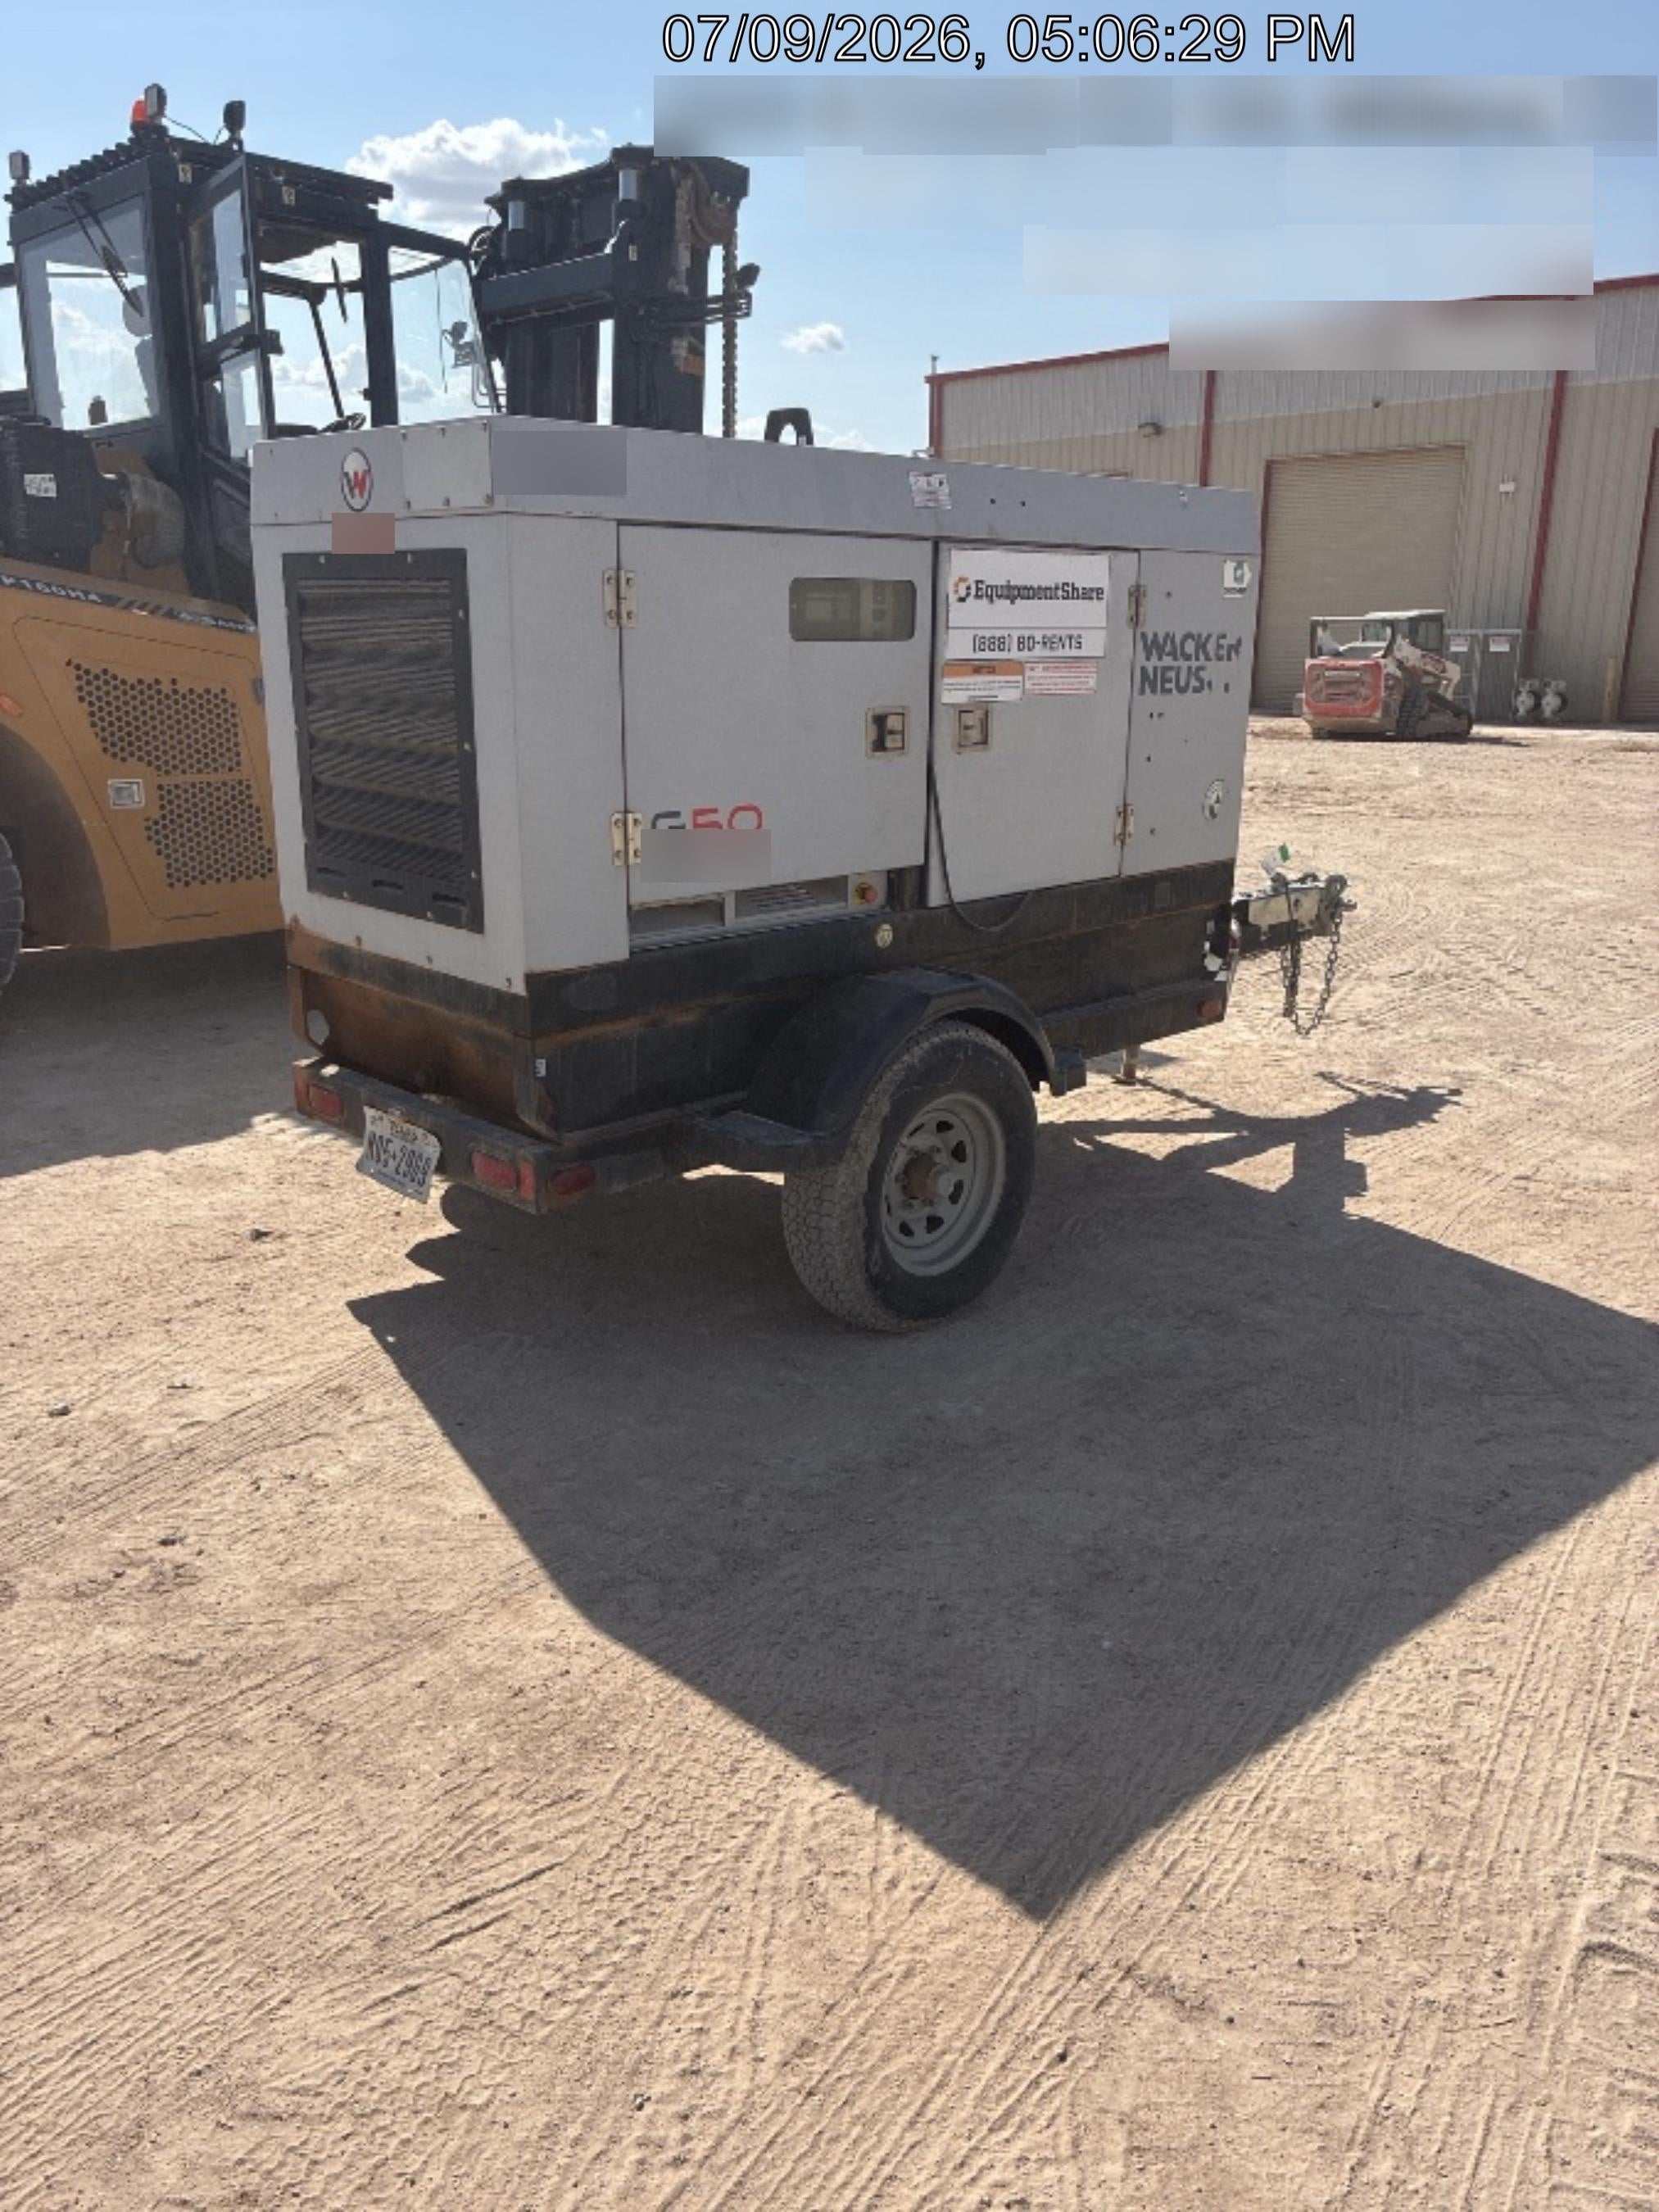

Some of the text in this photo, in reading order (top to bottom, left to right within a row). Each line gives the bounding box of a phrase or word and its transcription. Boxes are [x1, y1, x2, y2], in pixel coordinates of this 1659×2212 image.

[973, 580, 1105, 605] EquipmentShare
[972, 632, 1013, 655] (888)
[1138, 665, 1230, 695] NEUS
